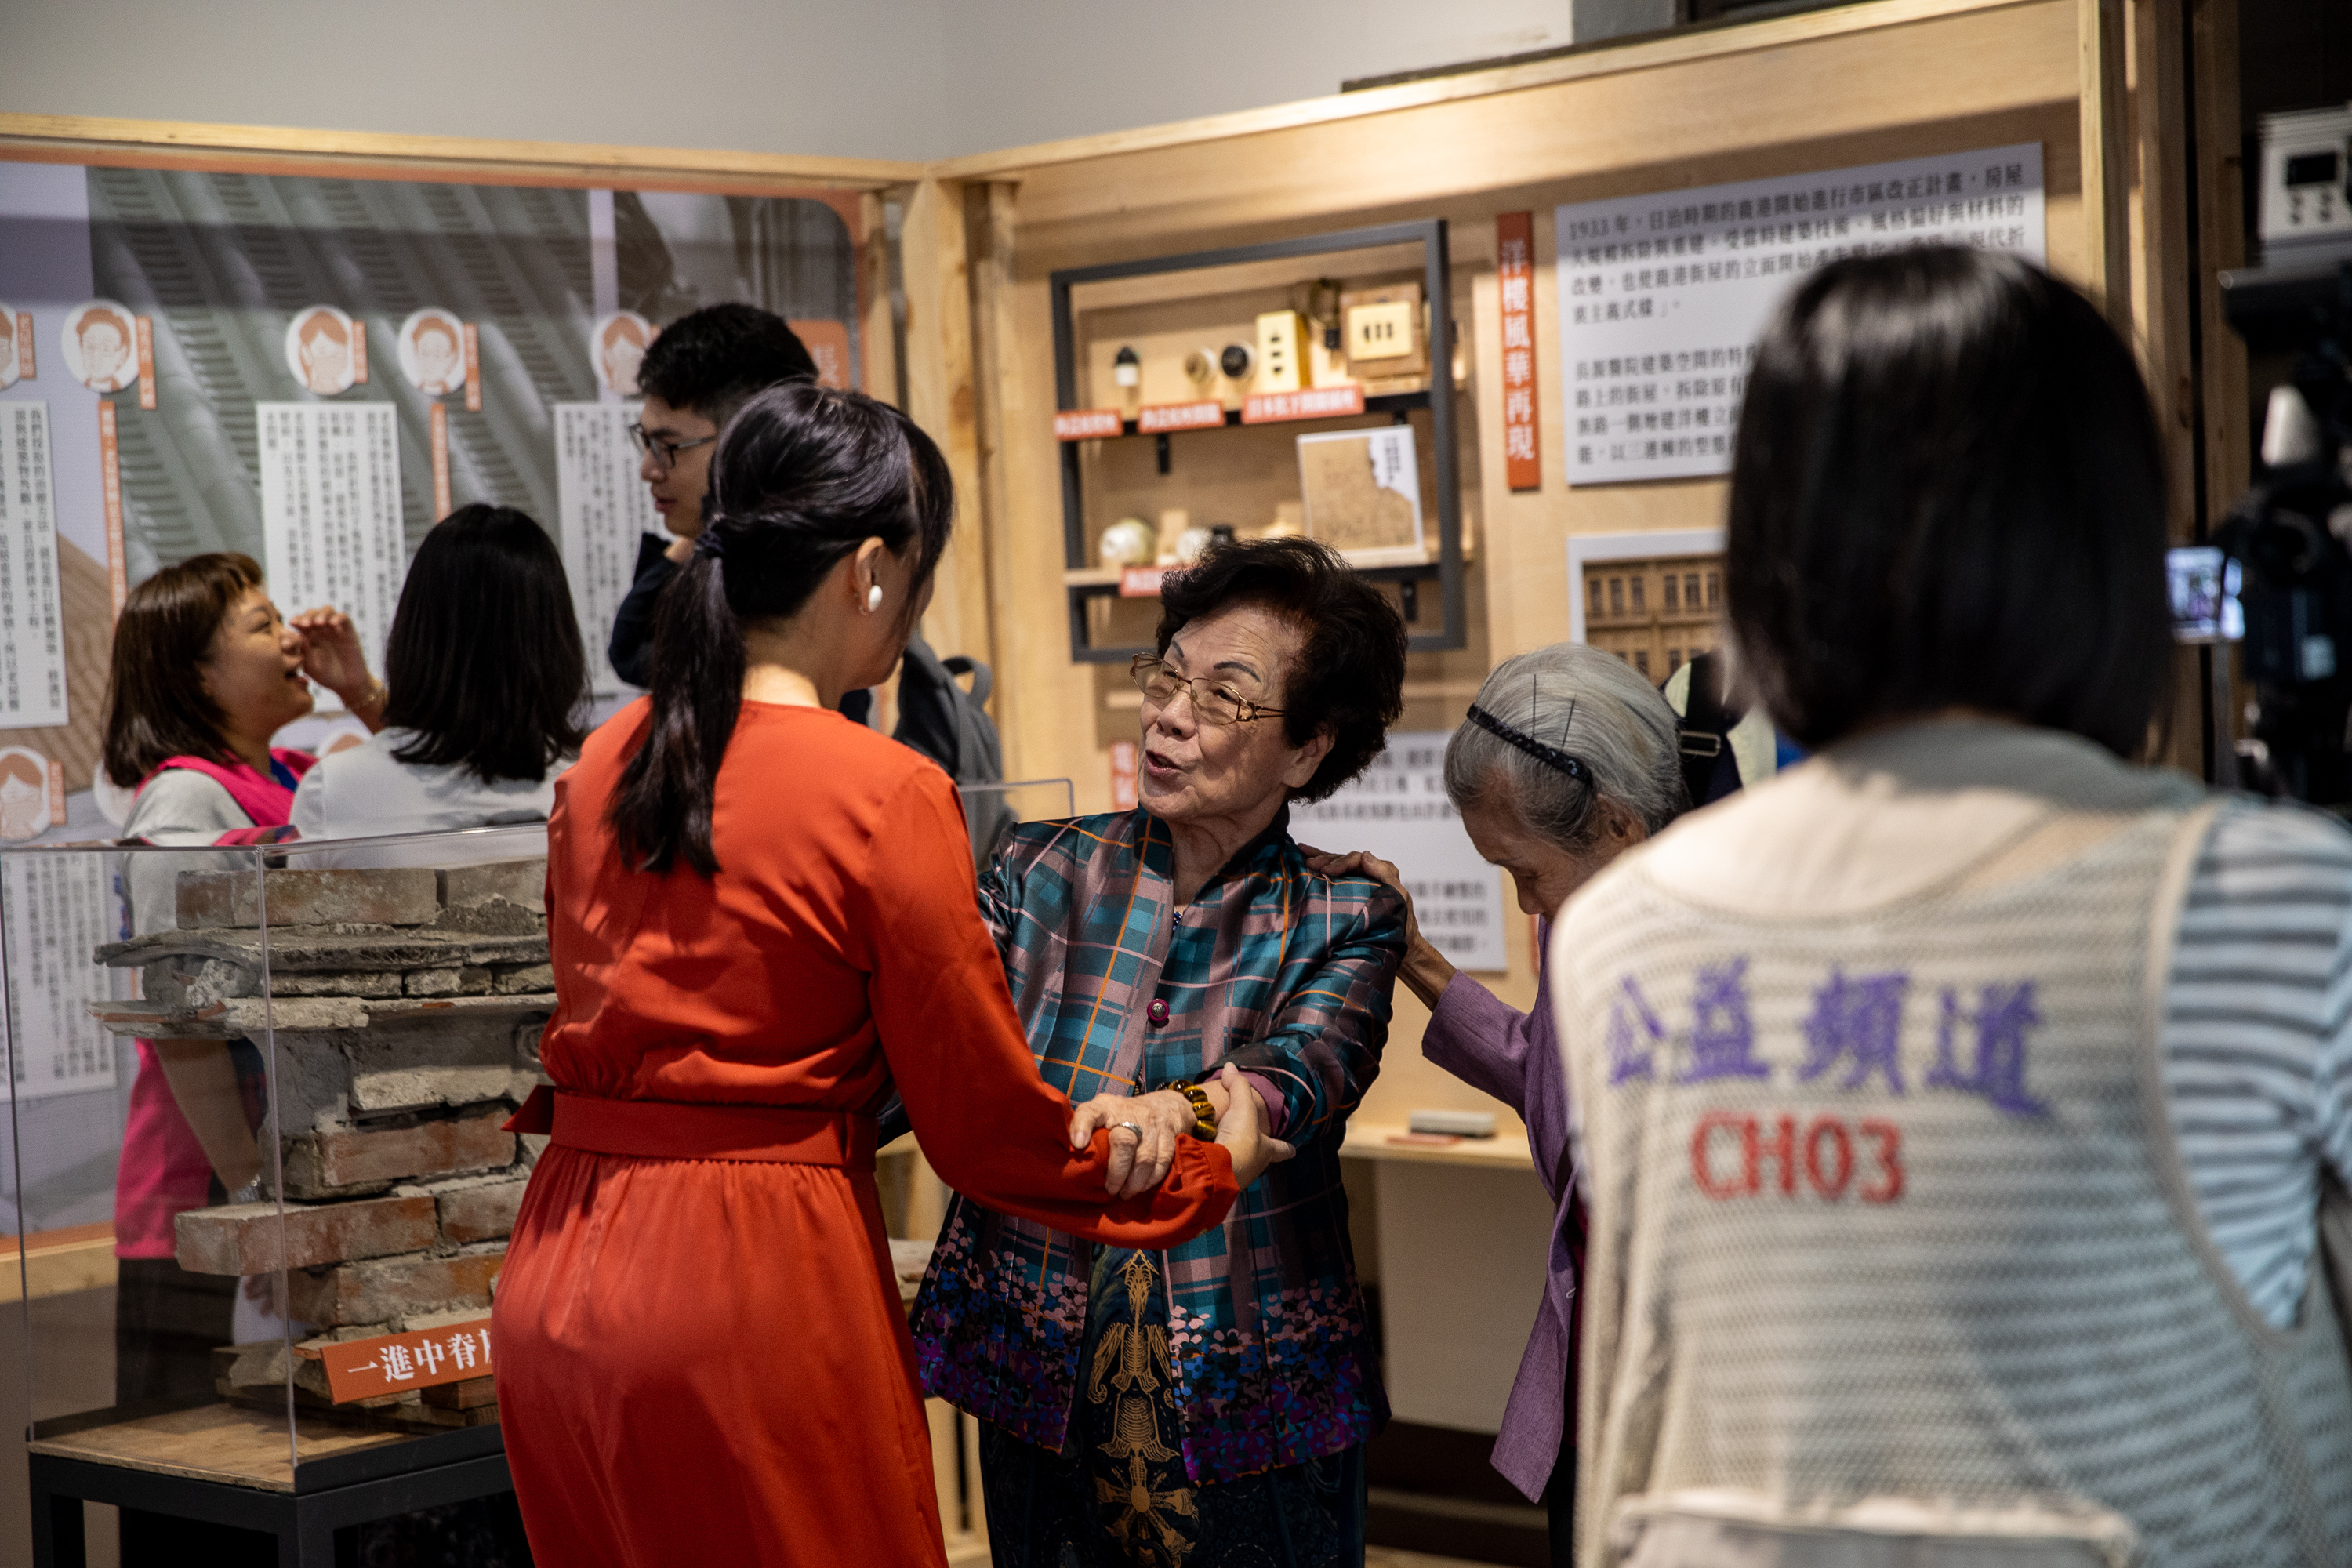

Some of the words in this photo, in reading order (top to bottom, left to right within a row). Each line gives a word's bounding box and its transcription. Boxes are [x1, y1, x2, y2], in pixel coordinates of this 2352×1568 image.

[1502, 238, 1535, 461] 洋樓風華再現
[1576, 374, 1751, 408] 路上的街屋，拆除原有
[1607, 955, 2056, 1121] 公益頻道
[1691, 1110, 1905, 1204] CH03
